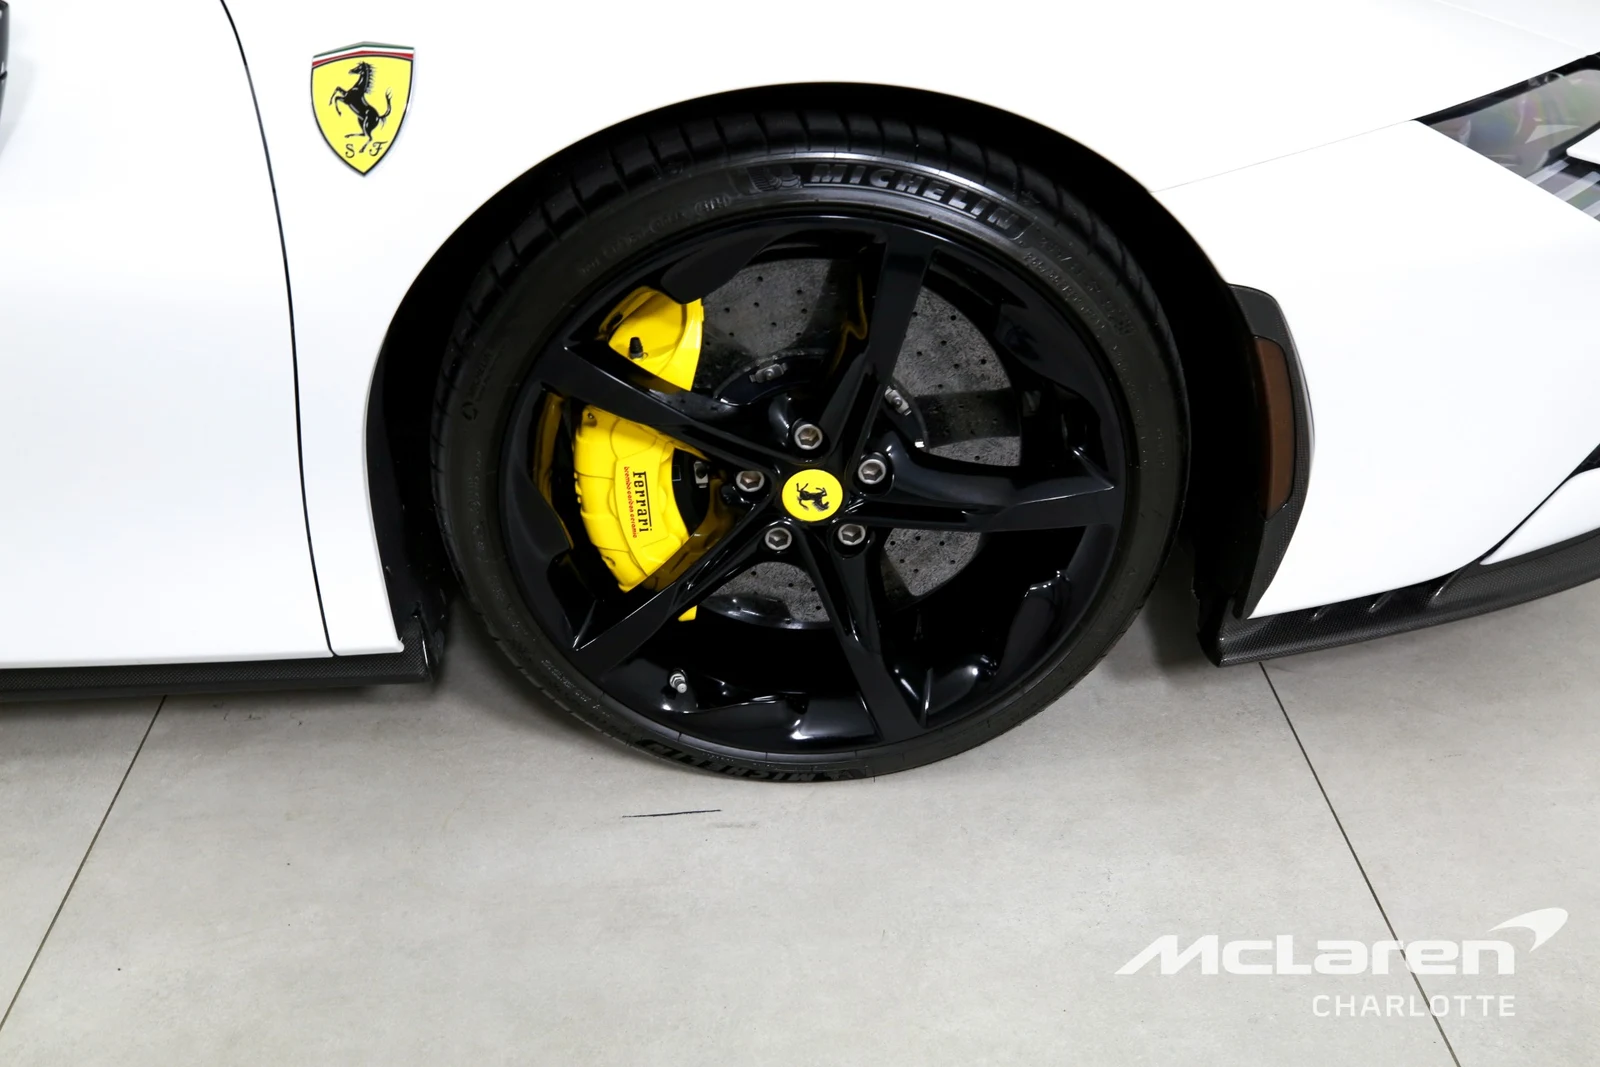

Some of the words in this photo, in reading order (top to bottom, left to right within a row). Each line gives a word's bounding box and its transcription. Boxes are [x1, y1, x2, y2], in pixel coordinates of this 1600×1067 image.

[345, 143, 355, 159] S
[369, 141, 388, 157] F
[813, 163, 1019, 230] MICHELIN
[632, 471, 652, 532] Ferrari
